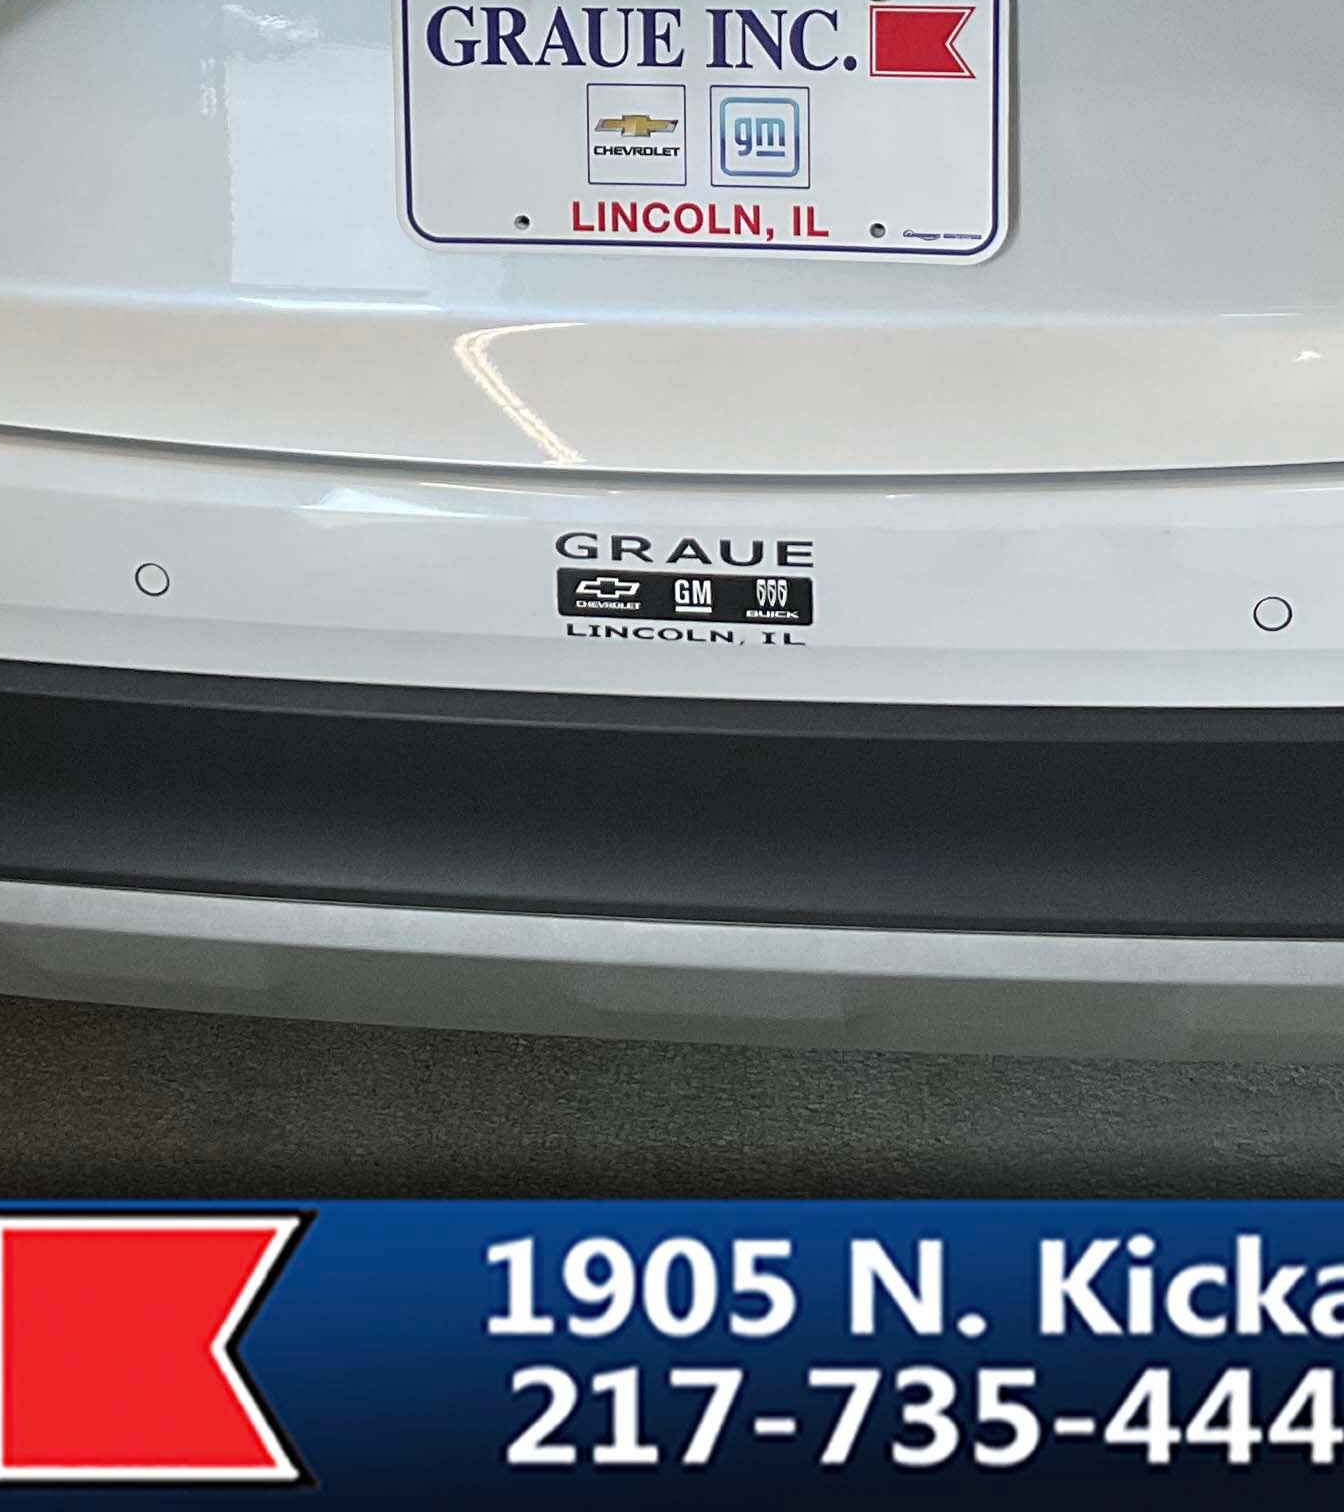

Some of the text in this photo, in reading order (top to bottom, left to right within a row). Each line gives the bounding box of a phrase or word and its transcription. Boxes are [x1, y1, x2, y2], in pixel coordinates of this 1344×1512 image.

[426, 5, 857, 72] GRAUE INC.
[734, 117, 786, 157] gm
[593, 144, 680, 159] CHEVROLET
[572, 201, 830, 243] LINCOLN, IL
[556, 532, 814, 568] GRAUE
[674, 579, 712, 605] GM
[576, 600, 642, 611] CHEVROLET
[746, 609, 799, 619] BUICK
[567, 623, 806, 646] LINCOLN, IL
